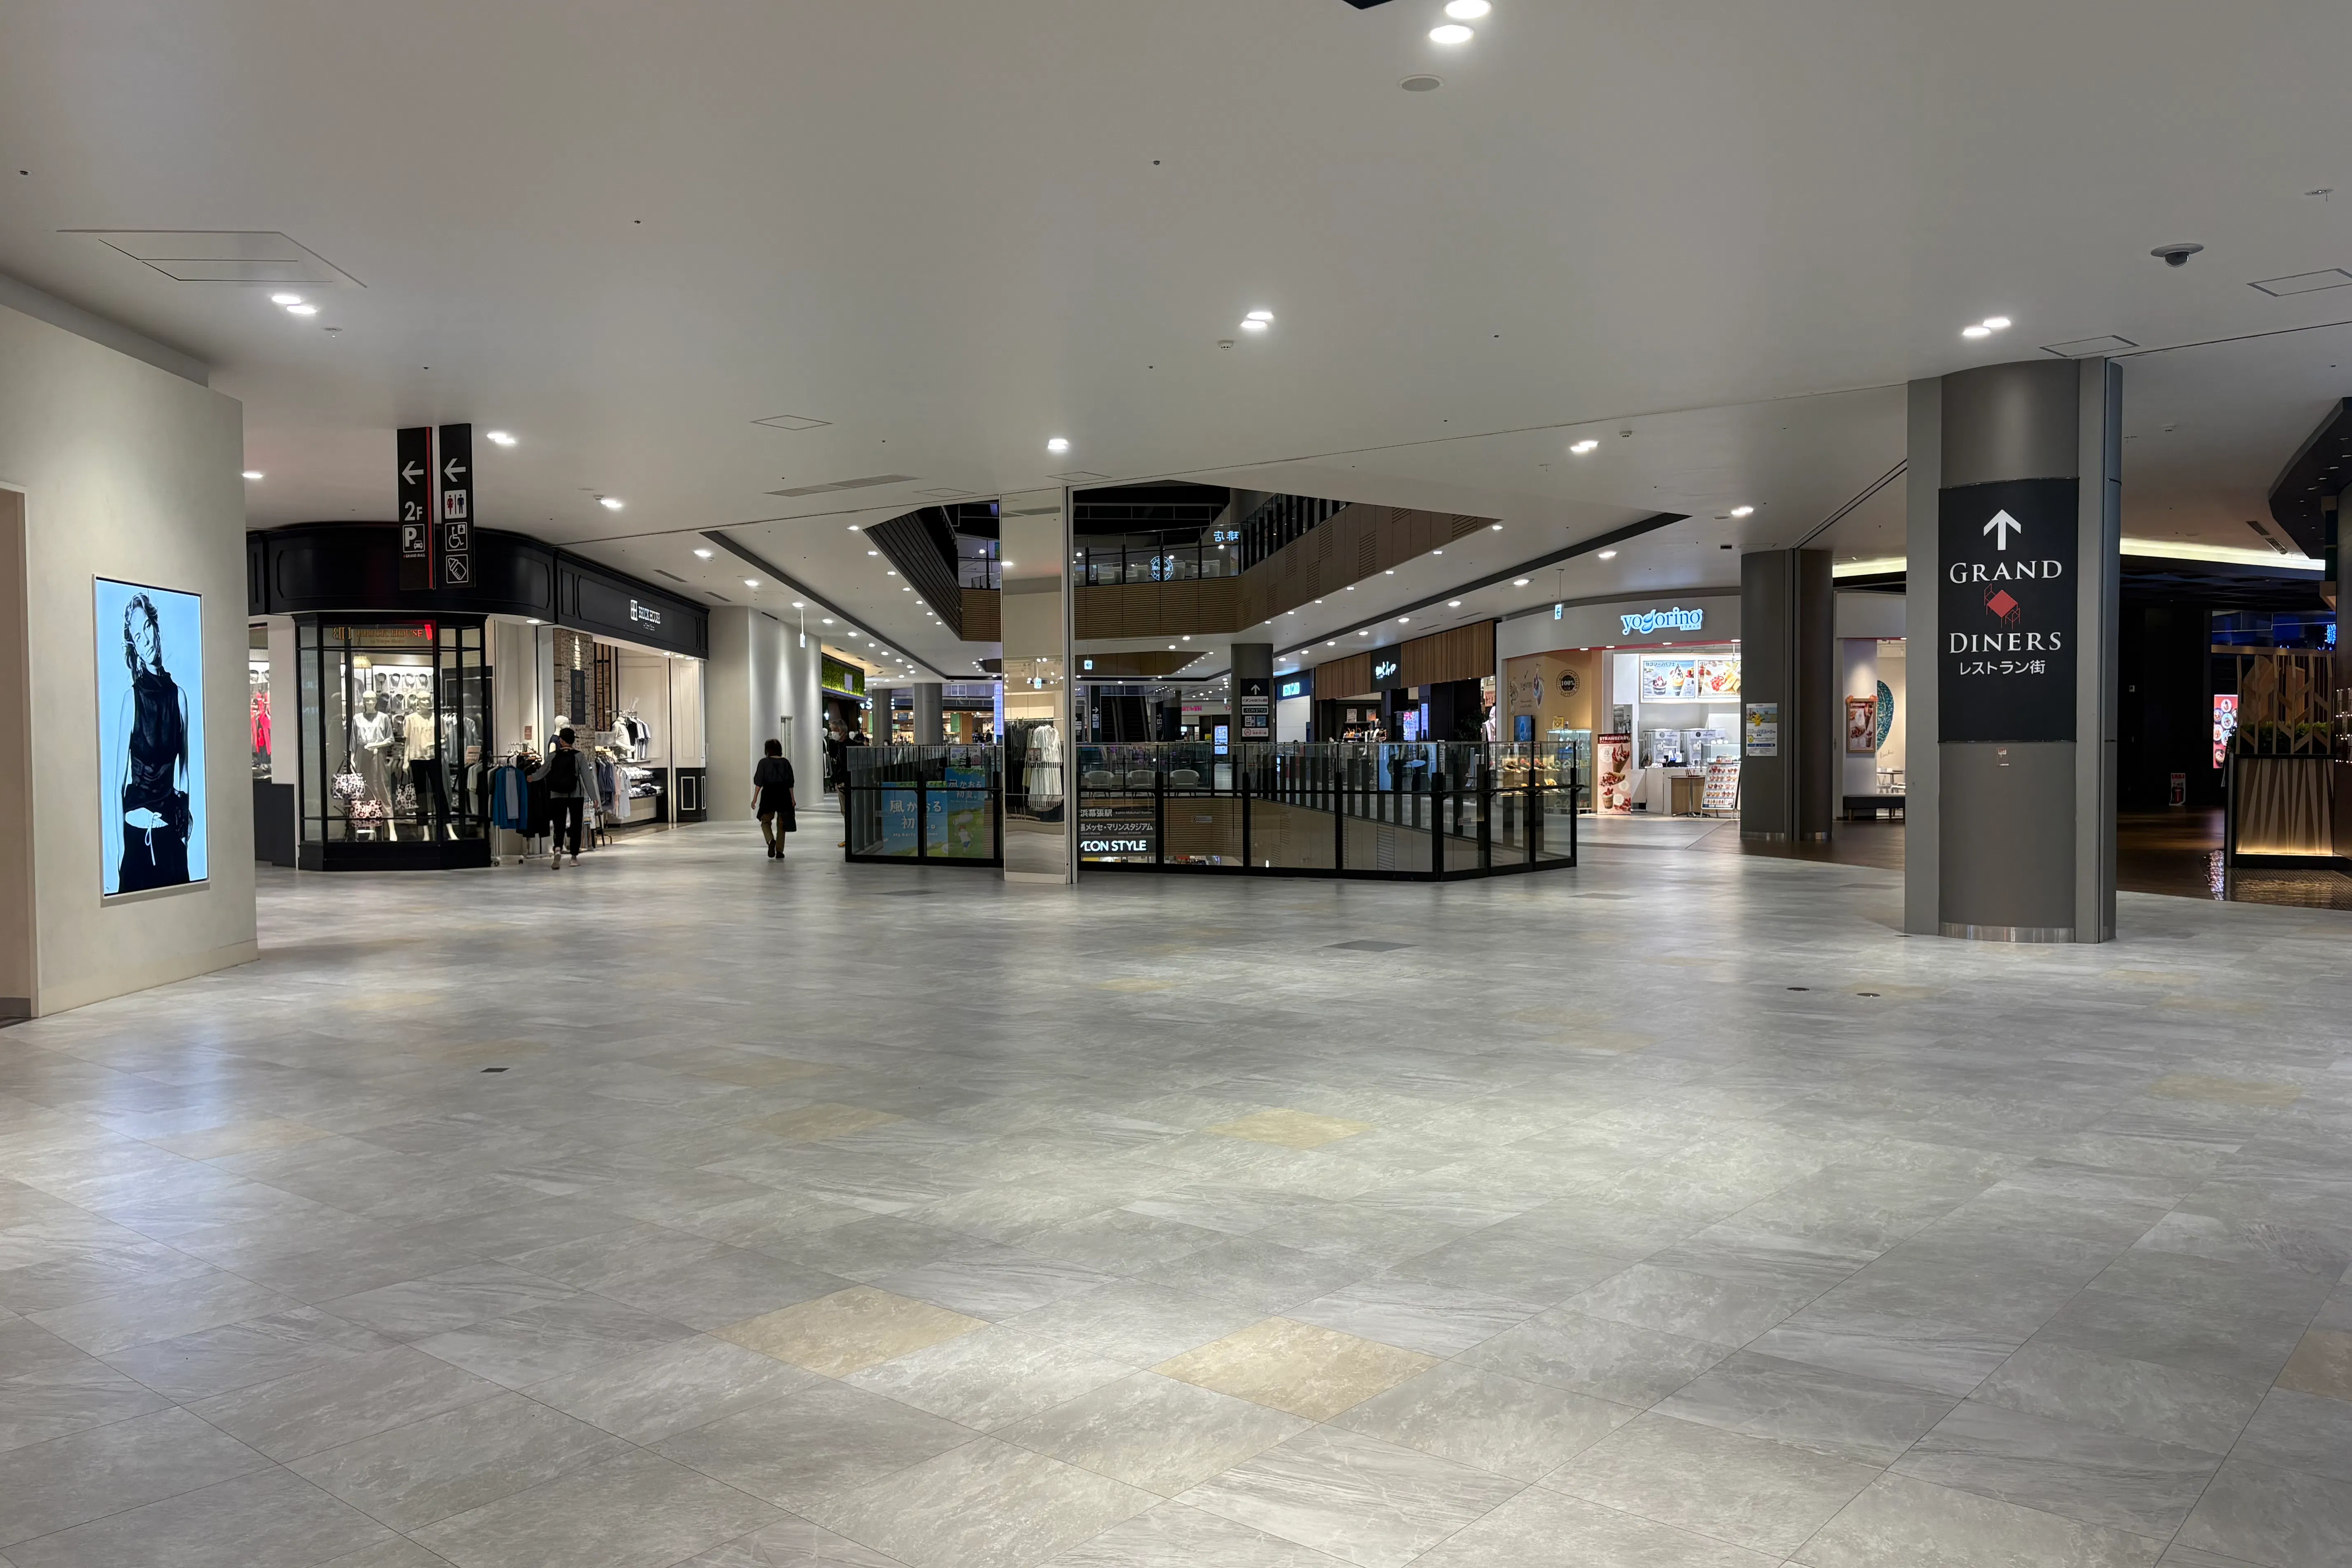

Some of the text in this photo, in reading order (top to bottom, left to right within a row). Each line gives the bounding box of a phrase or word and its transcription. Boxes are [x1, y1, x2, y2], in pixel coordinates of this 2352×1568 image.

[404, 501, 423, 521] 2F
[405, 527, 417, 547] P
[1950, 560, 2062, 583] GRAND
[1622, 609, 1701, 633] yogorino
[392, 629, 423, 637] HOUSE
[1949, 632, 2061, 653] DINERS
[1960, 660, 2045, 675] レストラン街
[901, 816, 936, 829] 初。
[1111, 840, 1147, 852] STYLE
